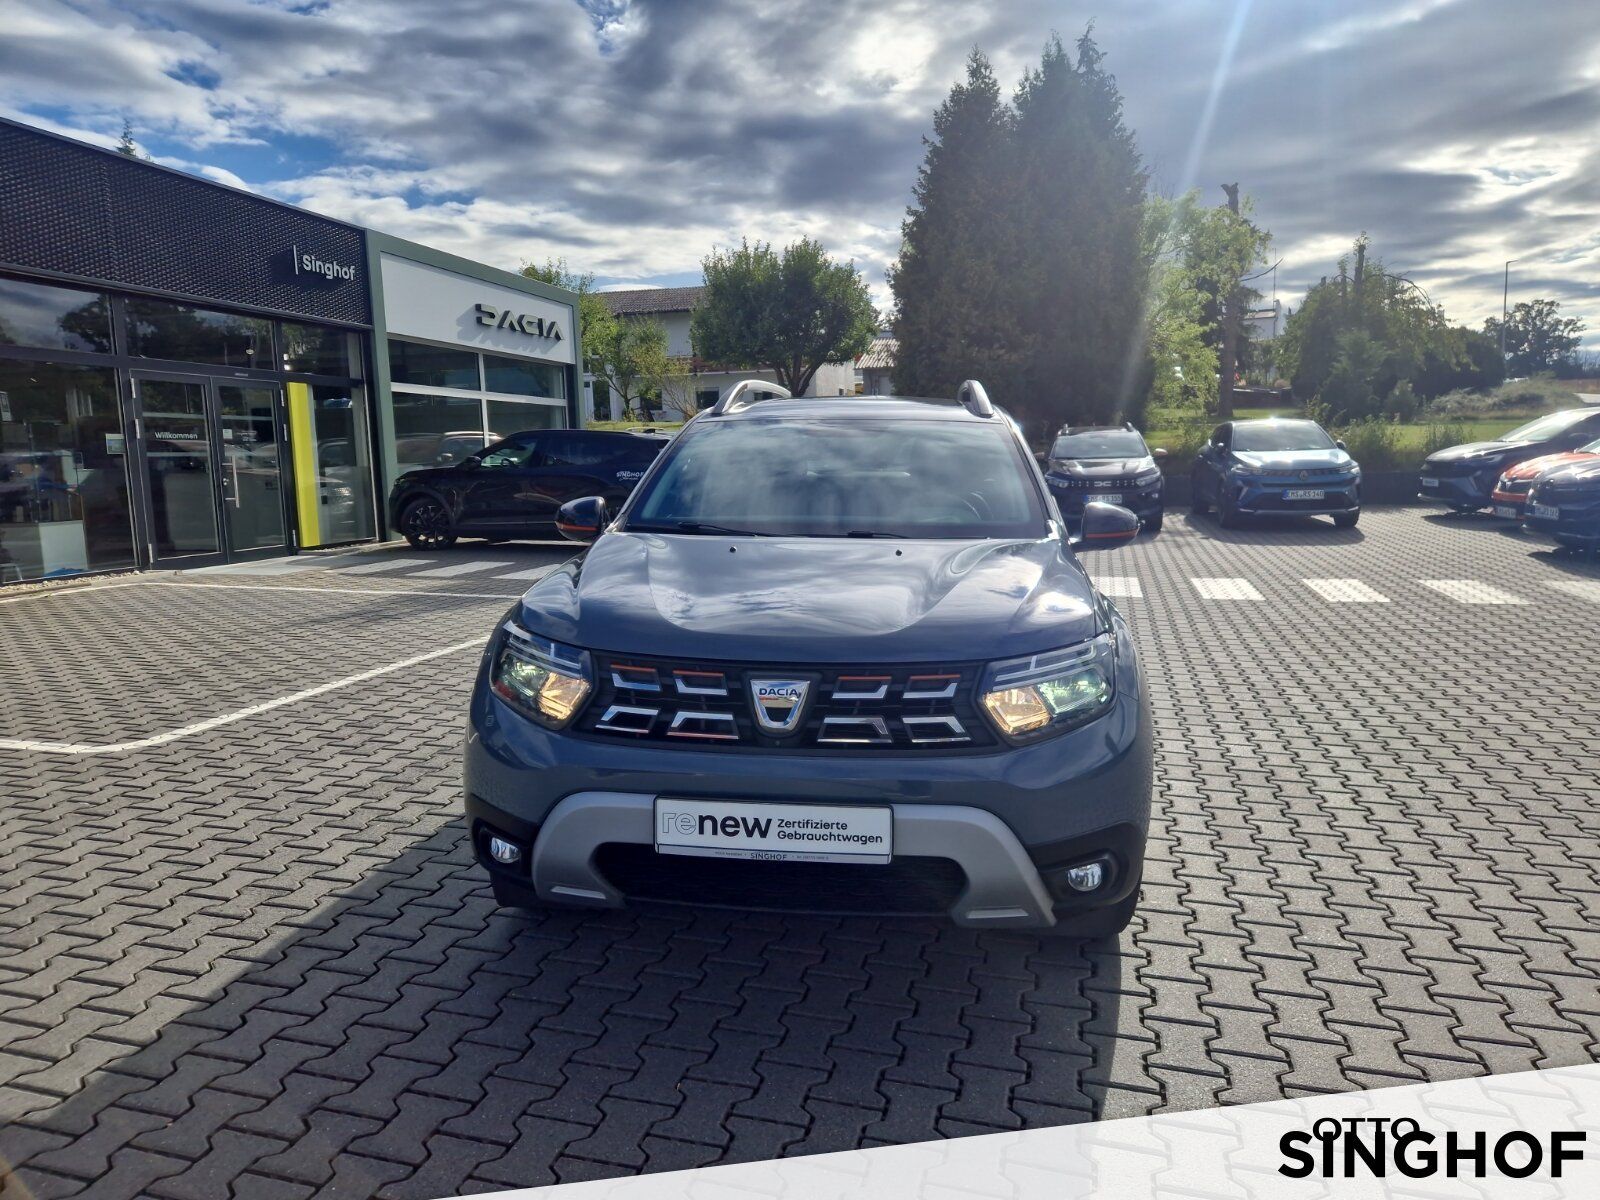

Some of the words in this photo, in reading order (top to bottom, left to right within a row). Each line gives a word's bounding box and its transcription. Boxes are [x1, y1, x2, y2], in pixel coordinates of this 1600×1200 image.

[302, 252, 356, 282] Singhof
[475, 302, 563, 341] DACIA
[154, 431, 198, 440] Willkommen
[758, 688, 798, 696] DACIA
[662, 812, 772, 838] renew
[777, 818, 848, 830] Zertifizierte
[777, 830, 883, 845] Gebrauchtwagen
[750, 852, 788, 861] SINGHOF
